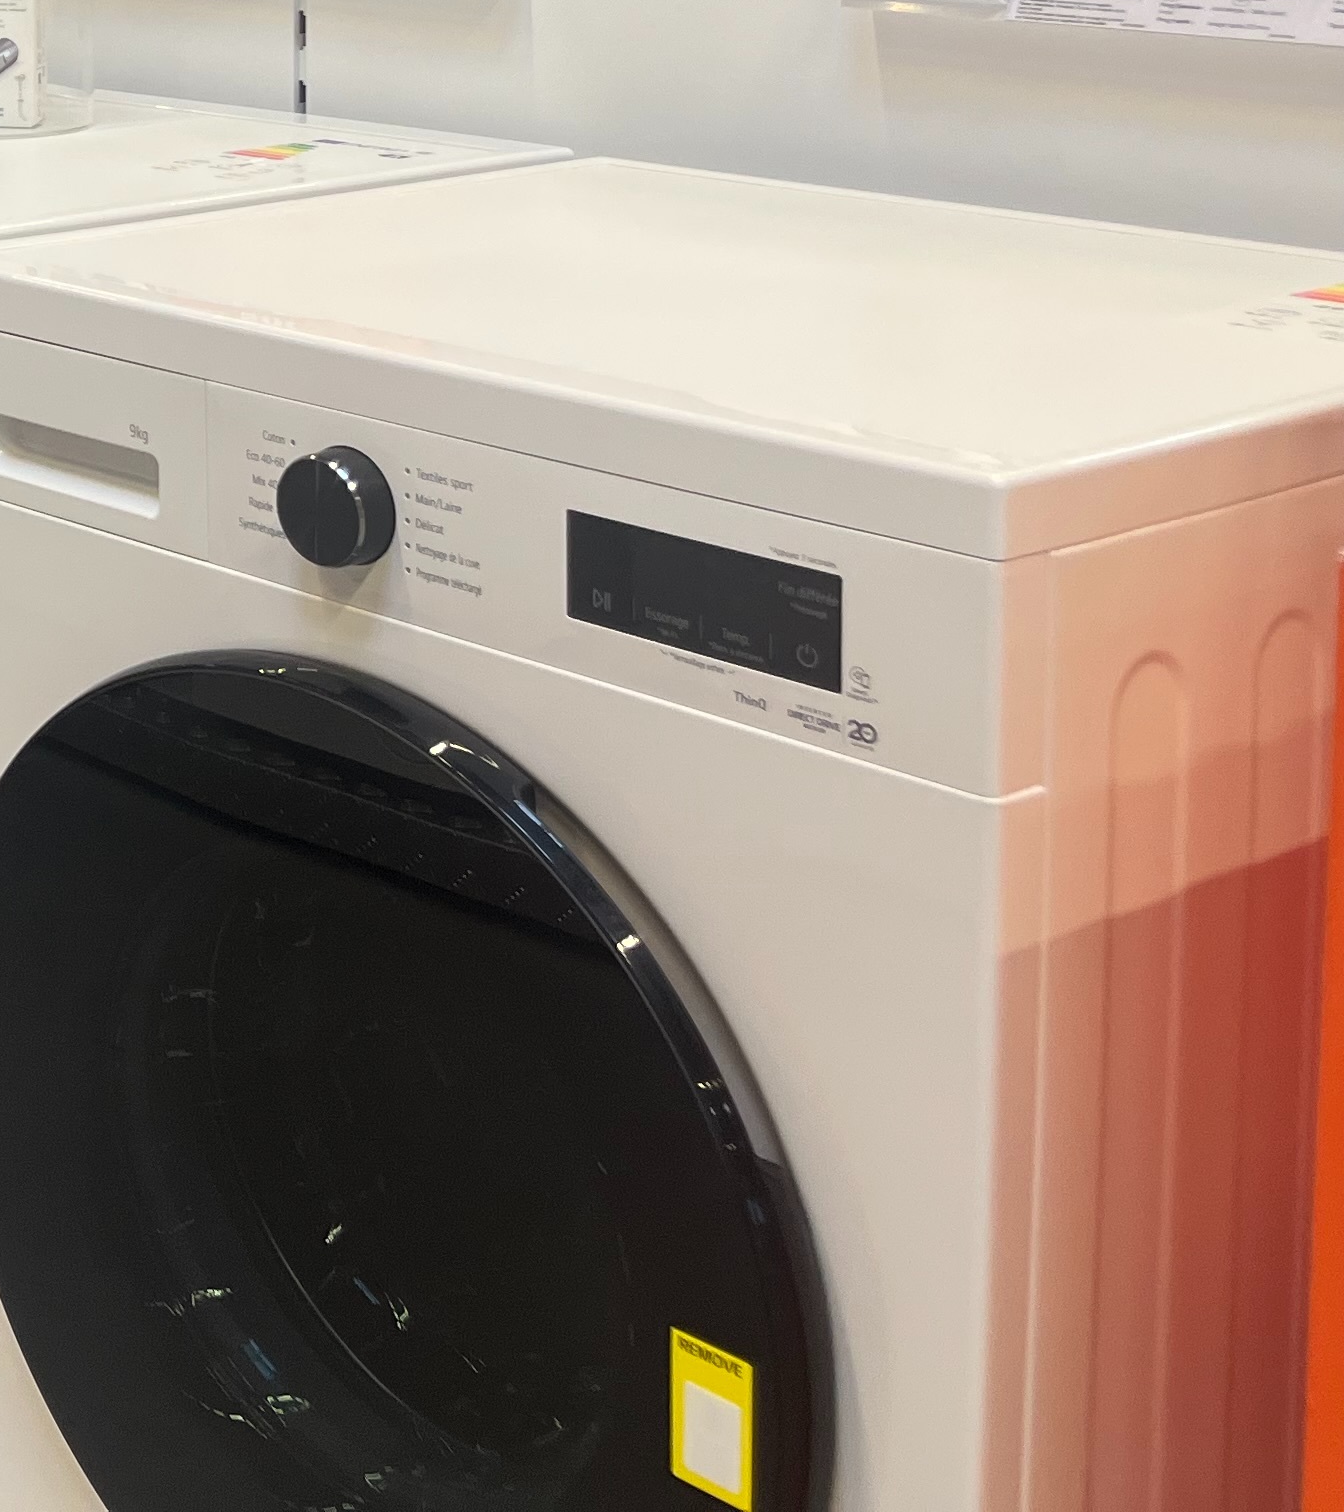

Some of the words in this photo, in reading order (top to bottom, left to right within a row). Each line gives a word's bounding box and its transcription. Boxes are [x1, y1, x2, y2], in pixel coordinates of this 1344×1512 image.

[415, 467, 449, 486] Textiles
[450, 477, 474, 493] sport
[733, 689, 768, 712] ThinQ
[678, 1337, 744, 1379] REMOVE
